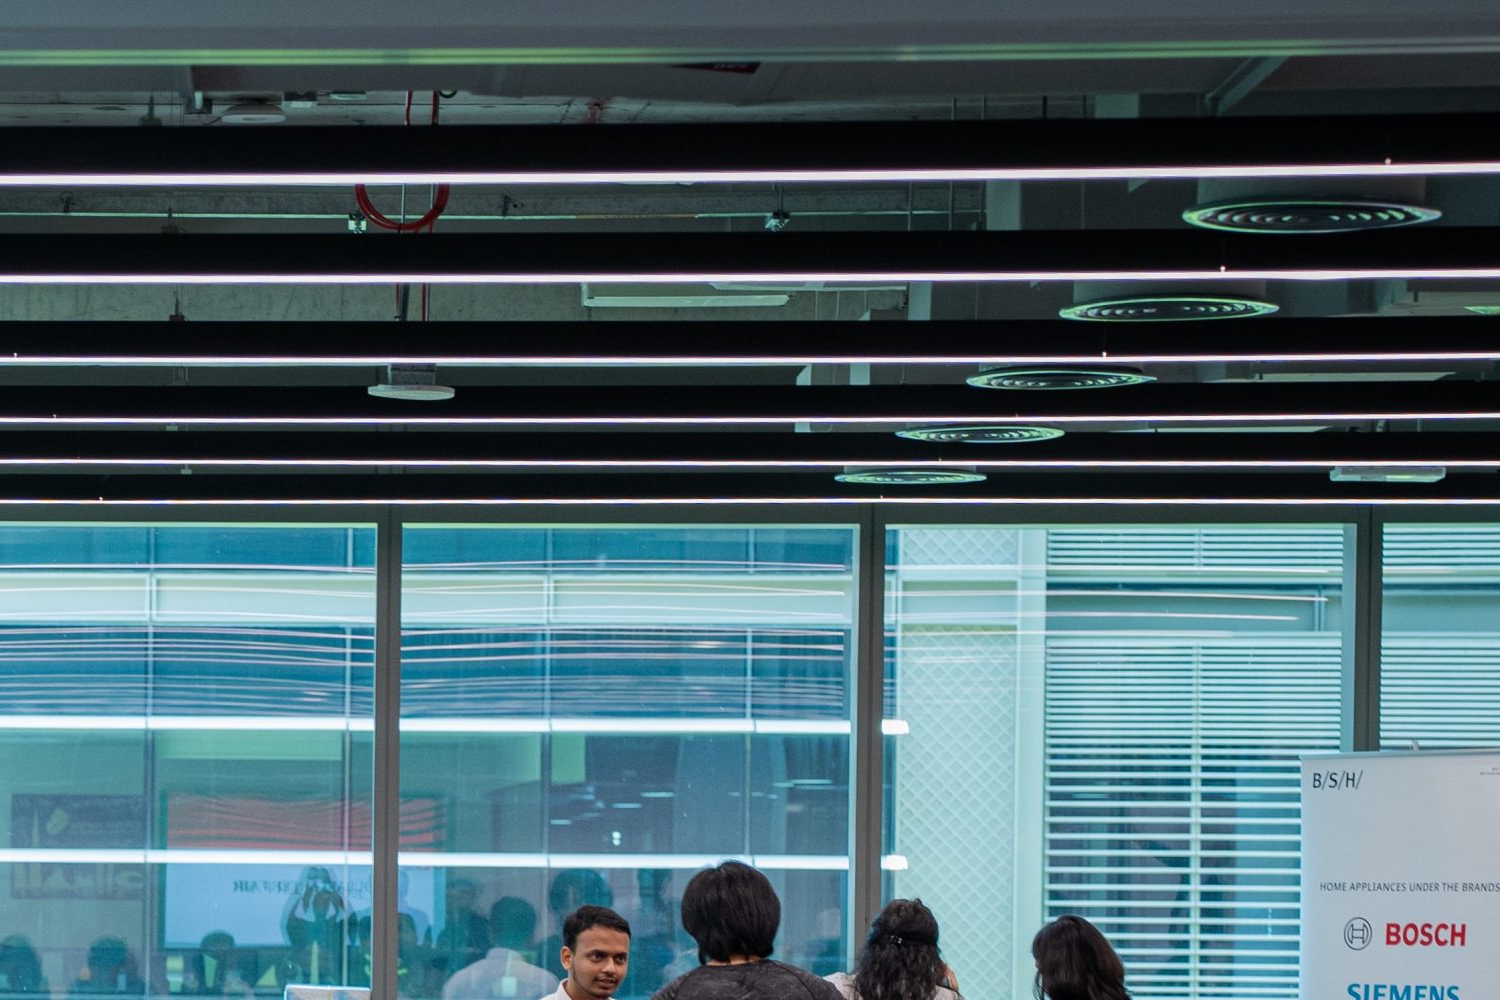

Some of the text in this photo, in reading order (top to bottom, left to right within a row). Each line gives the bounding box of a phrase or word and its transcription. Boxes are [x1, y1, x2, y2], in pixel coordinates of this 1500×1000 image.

[1320, 882, 1500, 893] HOME APPLIANCES UNDER THE BRANDS
[1385, 923, 1466, 947] BOSCH
